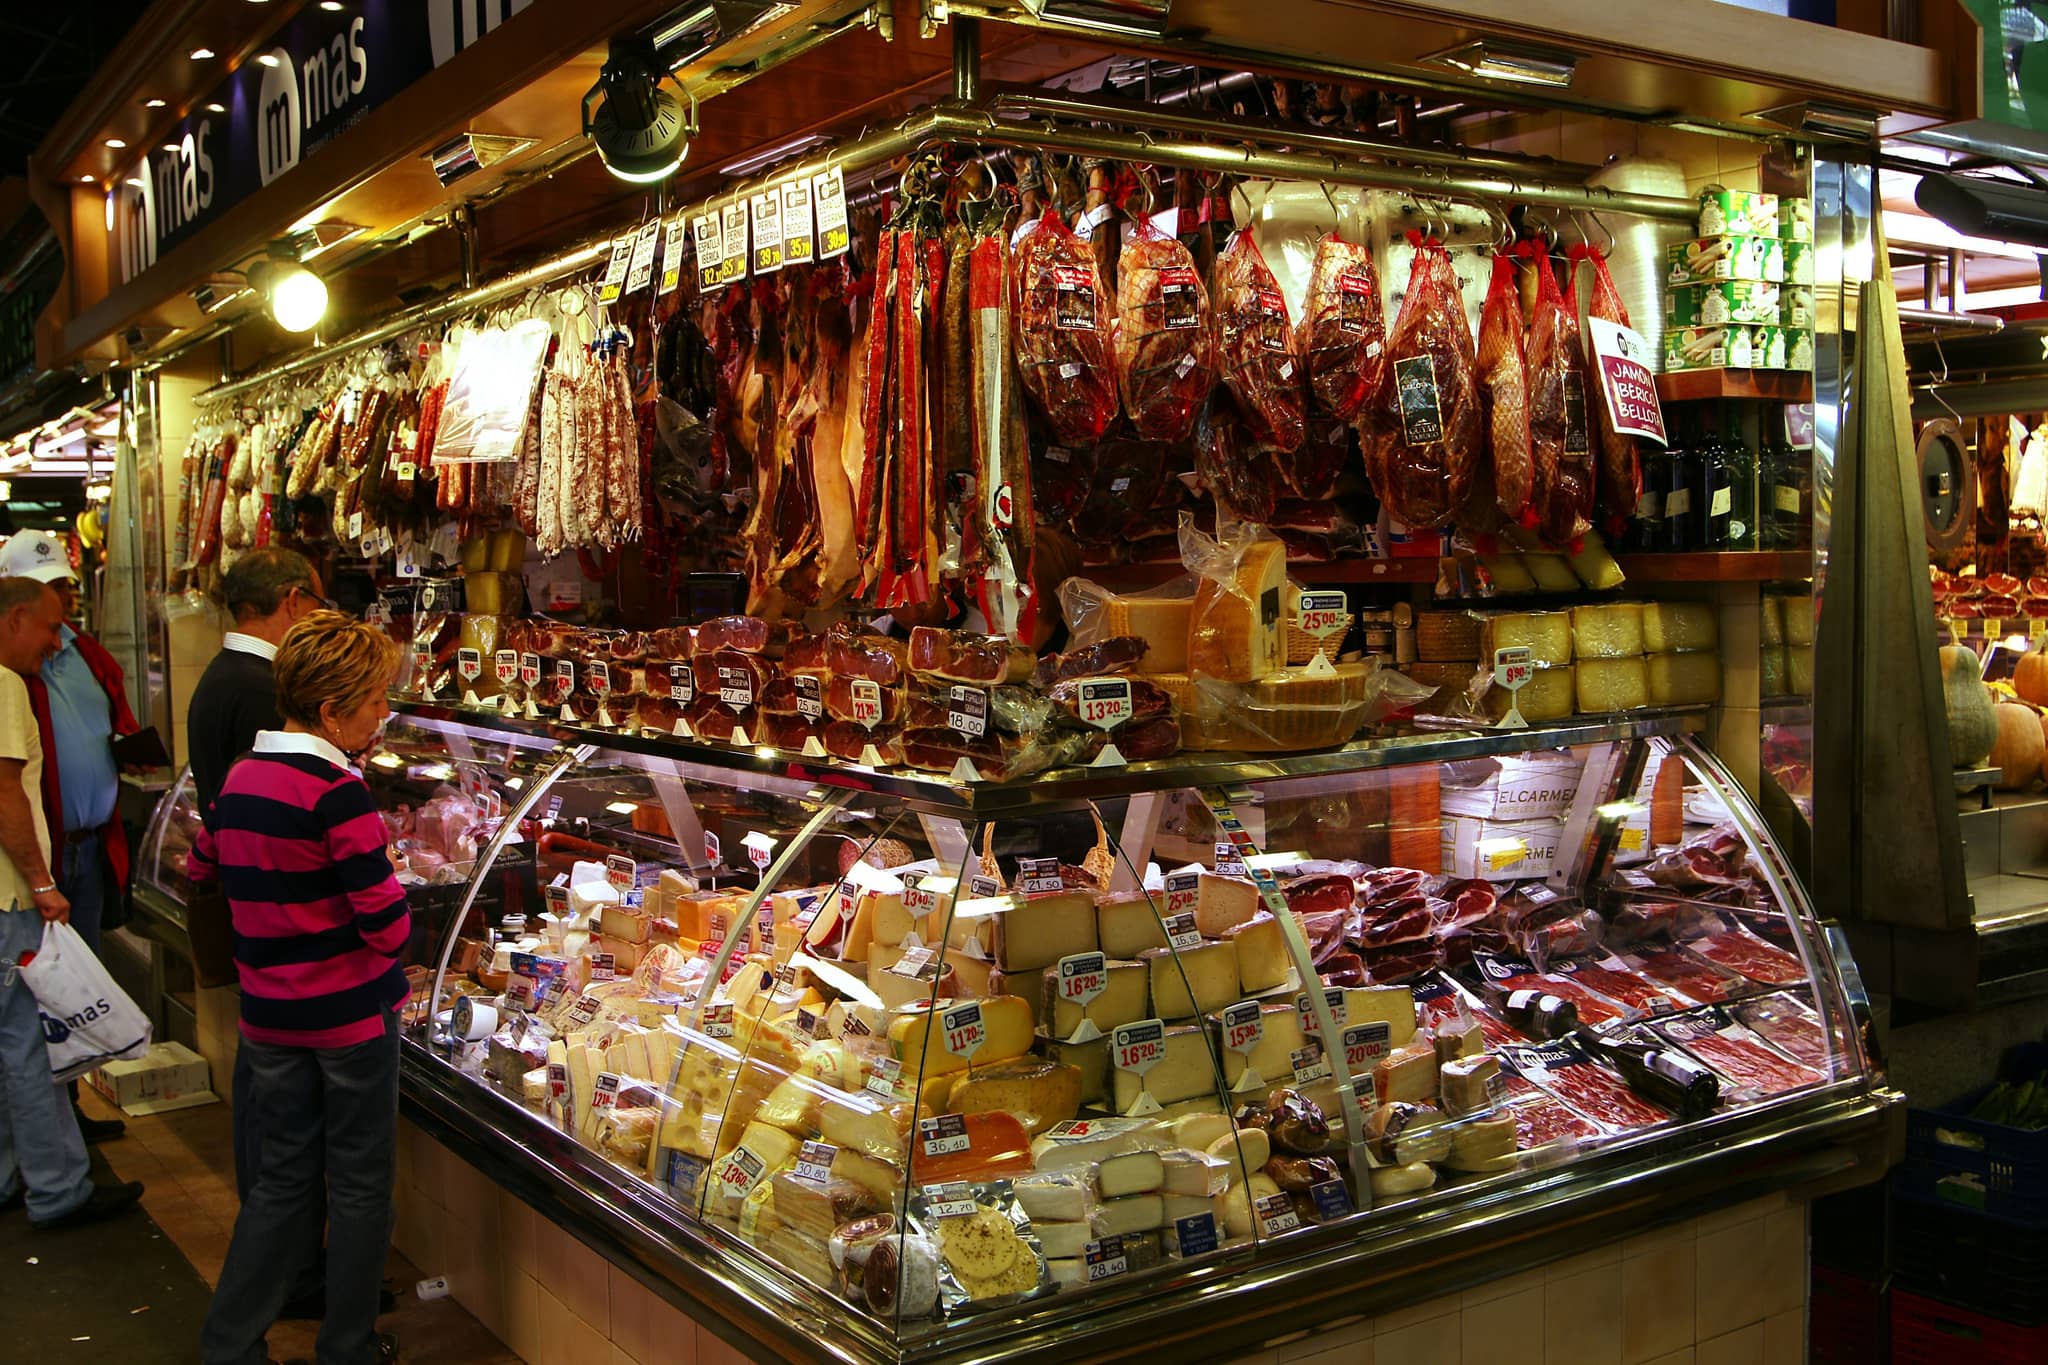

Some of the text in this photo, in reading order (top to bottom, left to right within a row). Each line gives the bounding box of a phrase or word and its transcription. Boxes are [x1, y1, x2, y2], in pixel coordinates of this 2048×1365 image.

[303, 16, 368, 130] mas
[157, 119, 214, 240] mas
[950, 713, 983, 733] 18.00
[65, 998, 111, 1029] mas
[1539, 1050, 1571, 1061] mas
